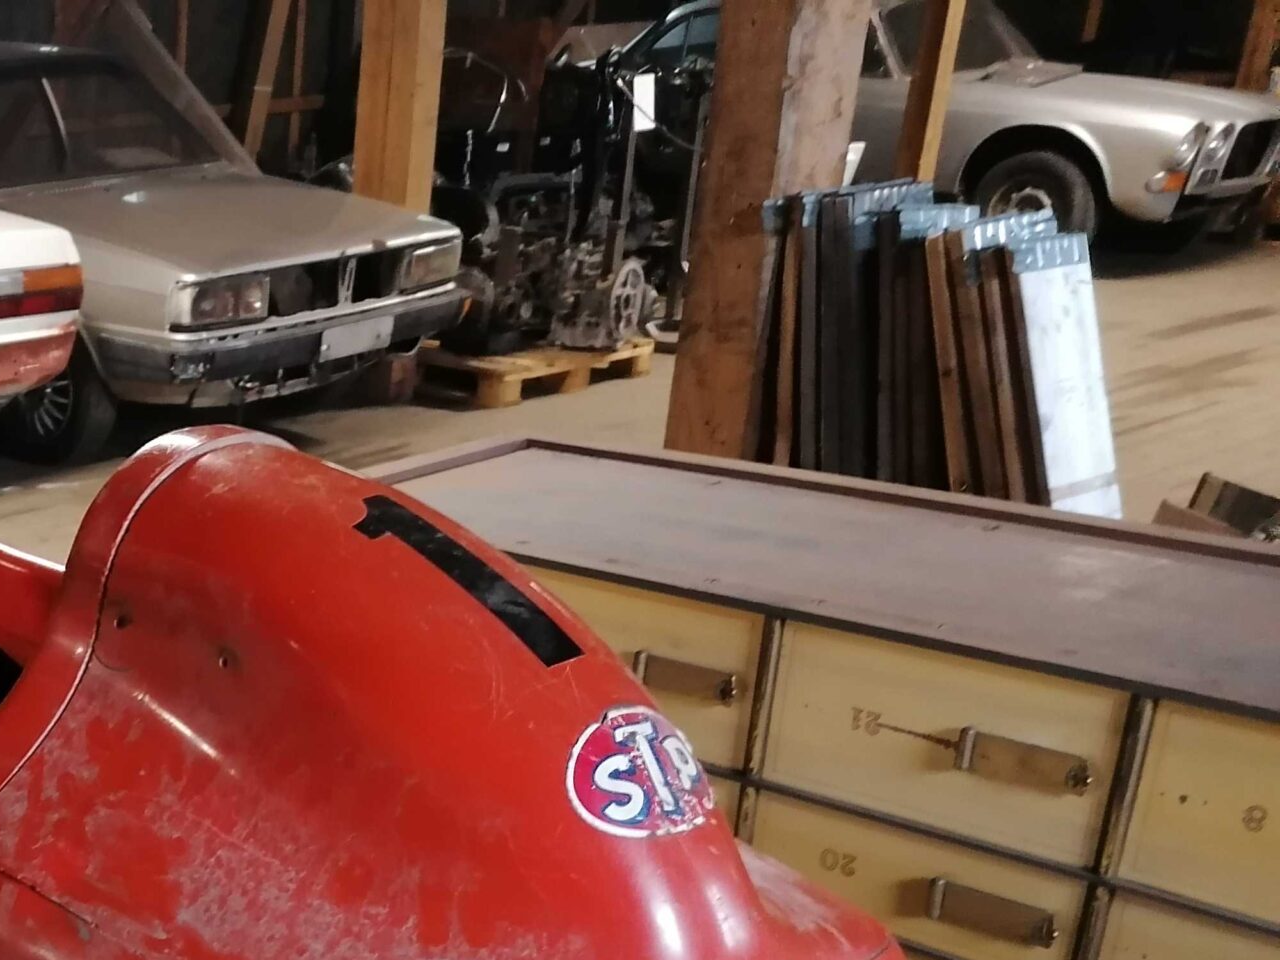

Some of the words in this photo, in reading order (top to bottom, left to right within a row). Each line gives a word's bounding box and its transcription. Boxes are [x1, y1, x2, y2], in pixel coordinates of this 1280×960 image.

[352, 495, 585, 668] 1
[850, 706, 882, 736] 21
[593, 720, 700, 822] STP
[820, 847, 857, 878] 20
